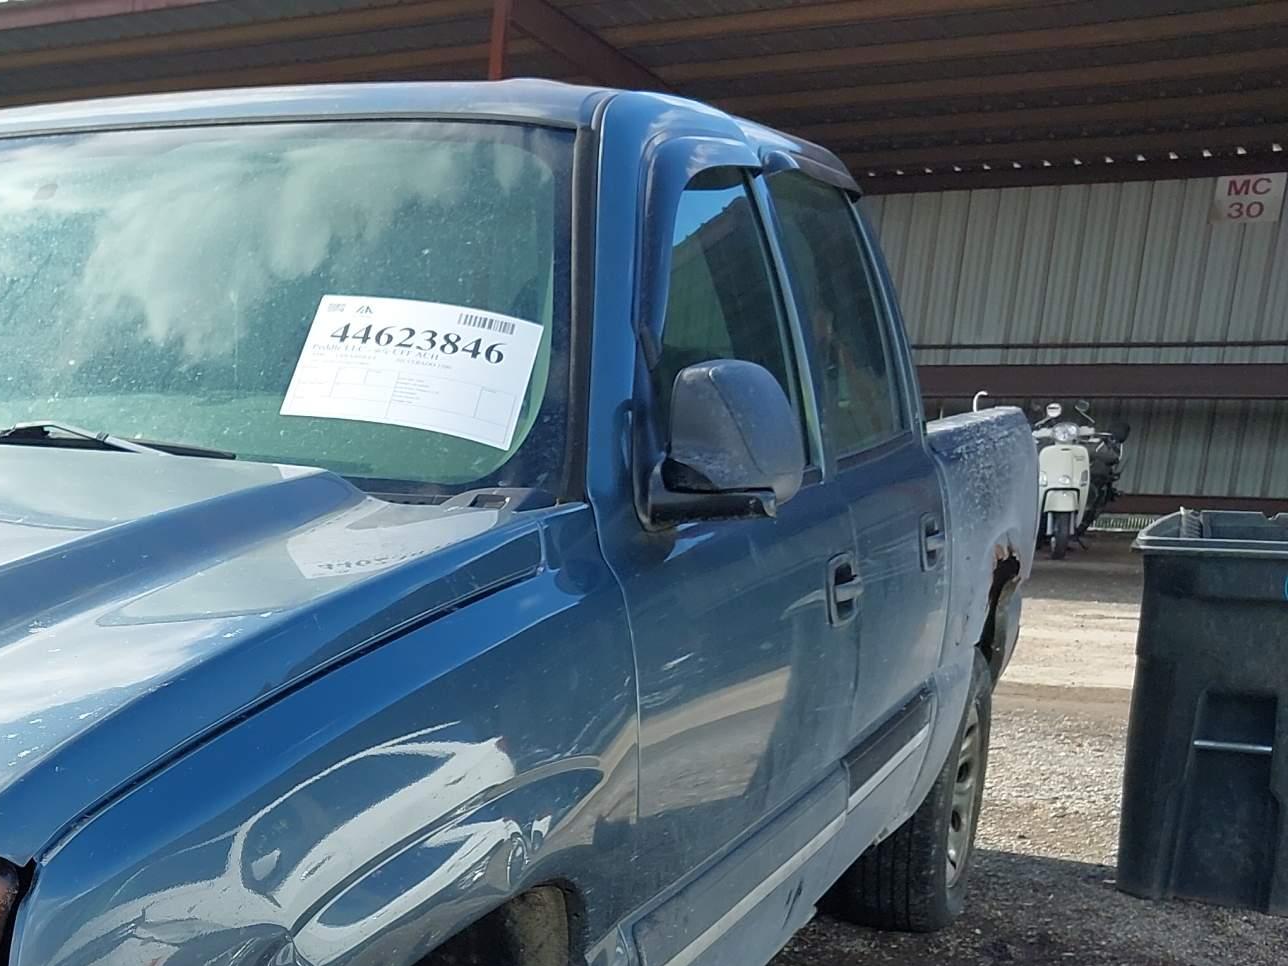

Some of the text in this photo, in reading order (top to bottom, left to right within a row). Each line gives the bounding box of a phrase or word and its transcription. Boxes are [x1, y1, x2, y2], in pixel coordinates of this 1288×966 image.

[1227, 177, 1272, 196] MC
[1227, 201, 1264, 219] 30
[330, 322, 510, 364] 44623846
